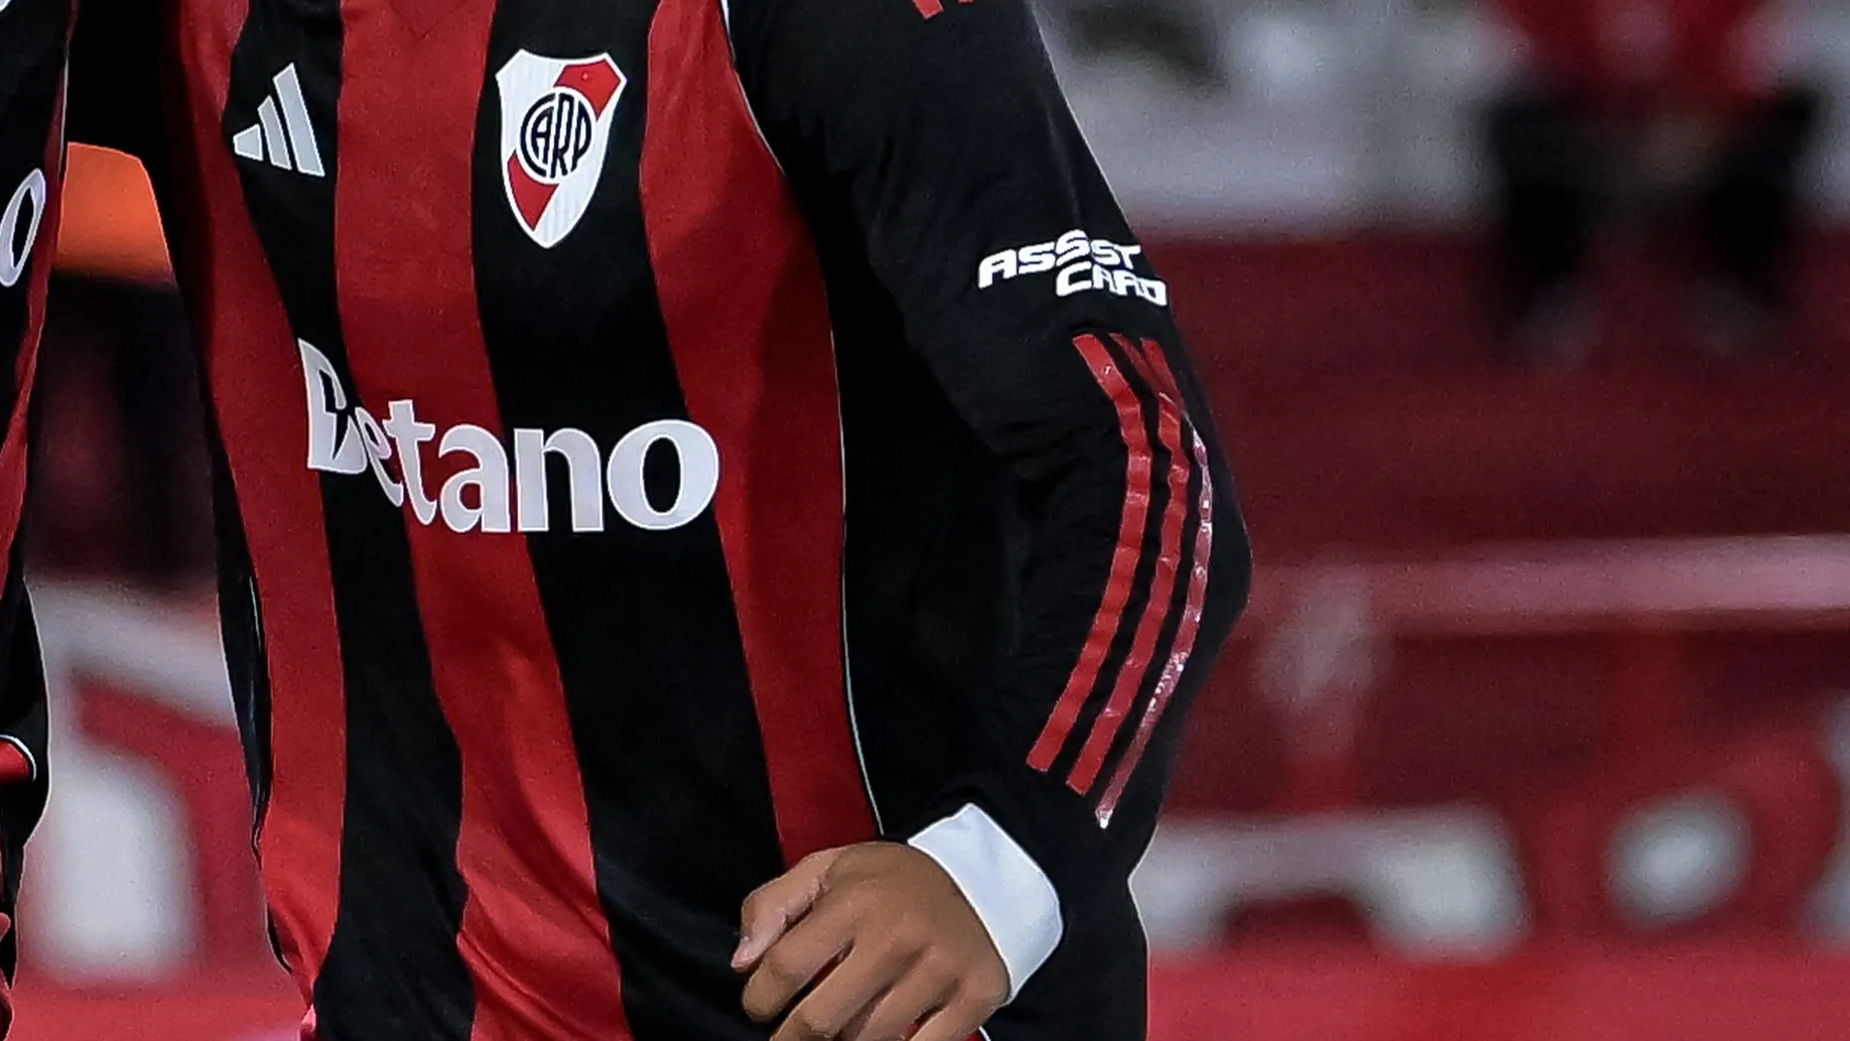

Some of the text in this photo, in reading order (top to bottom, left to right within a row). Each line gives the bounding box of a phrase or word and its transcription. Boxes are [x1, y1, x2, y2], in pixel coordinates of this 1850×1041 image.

[978, 229, 1141, 289] ASSST
[1056, 261, 1167, 306] CARD
[298, 338, 719, 532] Betano
